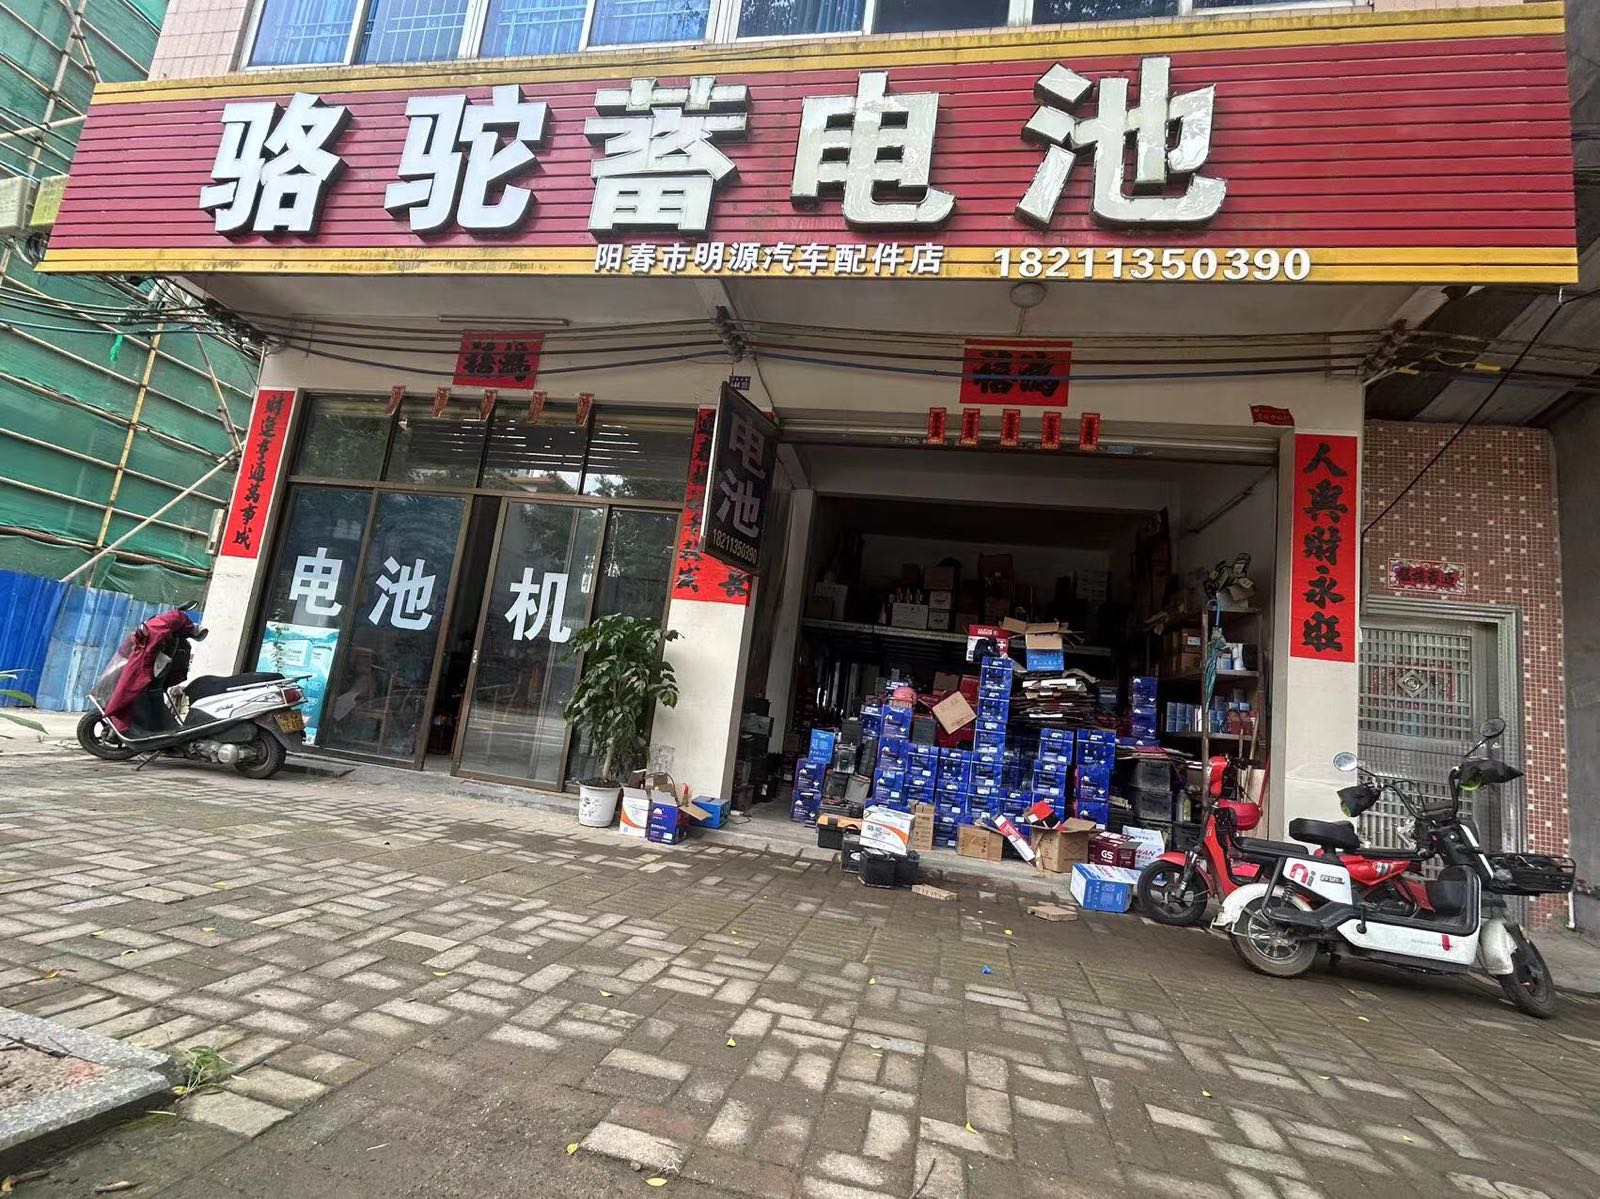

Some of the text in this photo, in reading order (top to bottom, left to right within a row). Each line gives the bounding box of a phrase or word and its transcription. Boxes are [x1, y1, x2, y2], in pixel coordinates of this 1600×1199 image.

[201, 57, 1227, 235] 骆驼蓄电池
[594, 242, 1312, 281] 阳春市明源汽车配件店 18211350390
[715, 411, 767, 538] 电池
[712, 528, 758, 565] 18211350390
